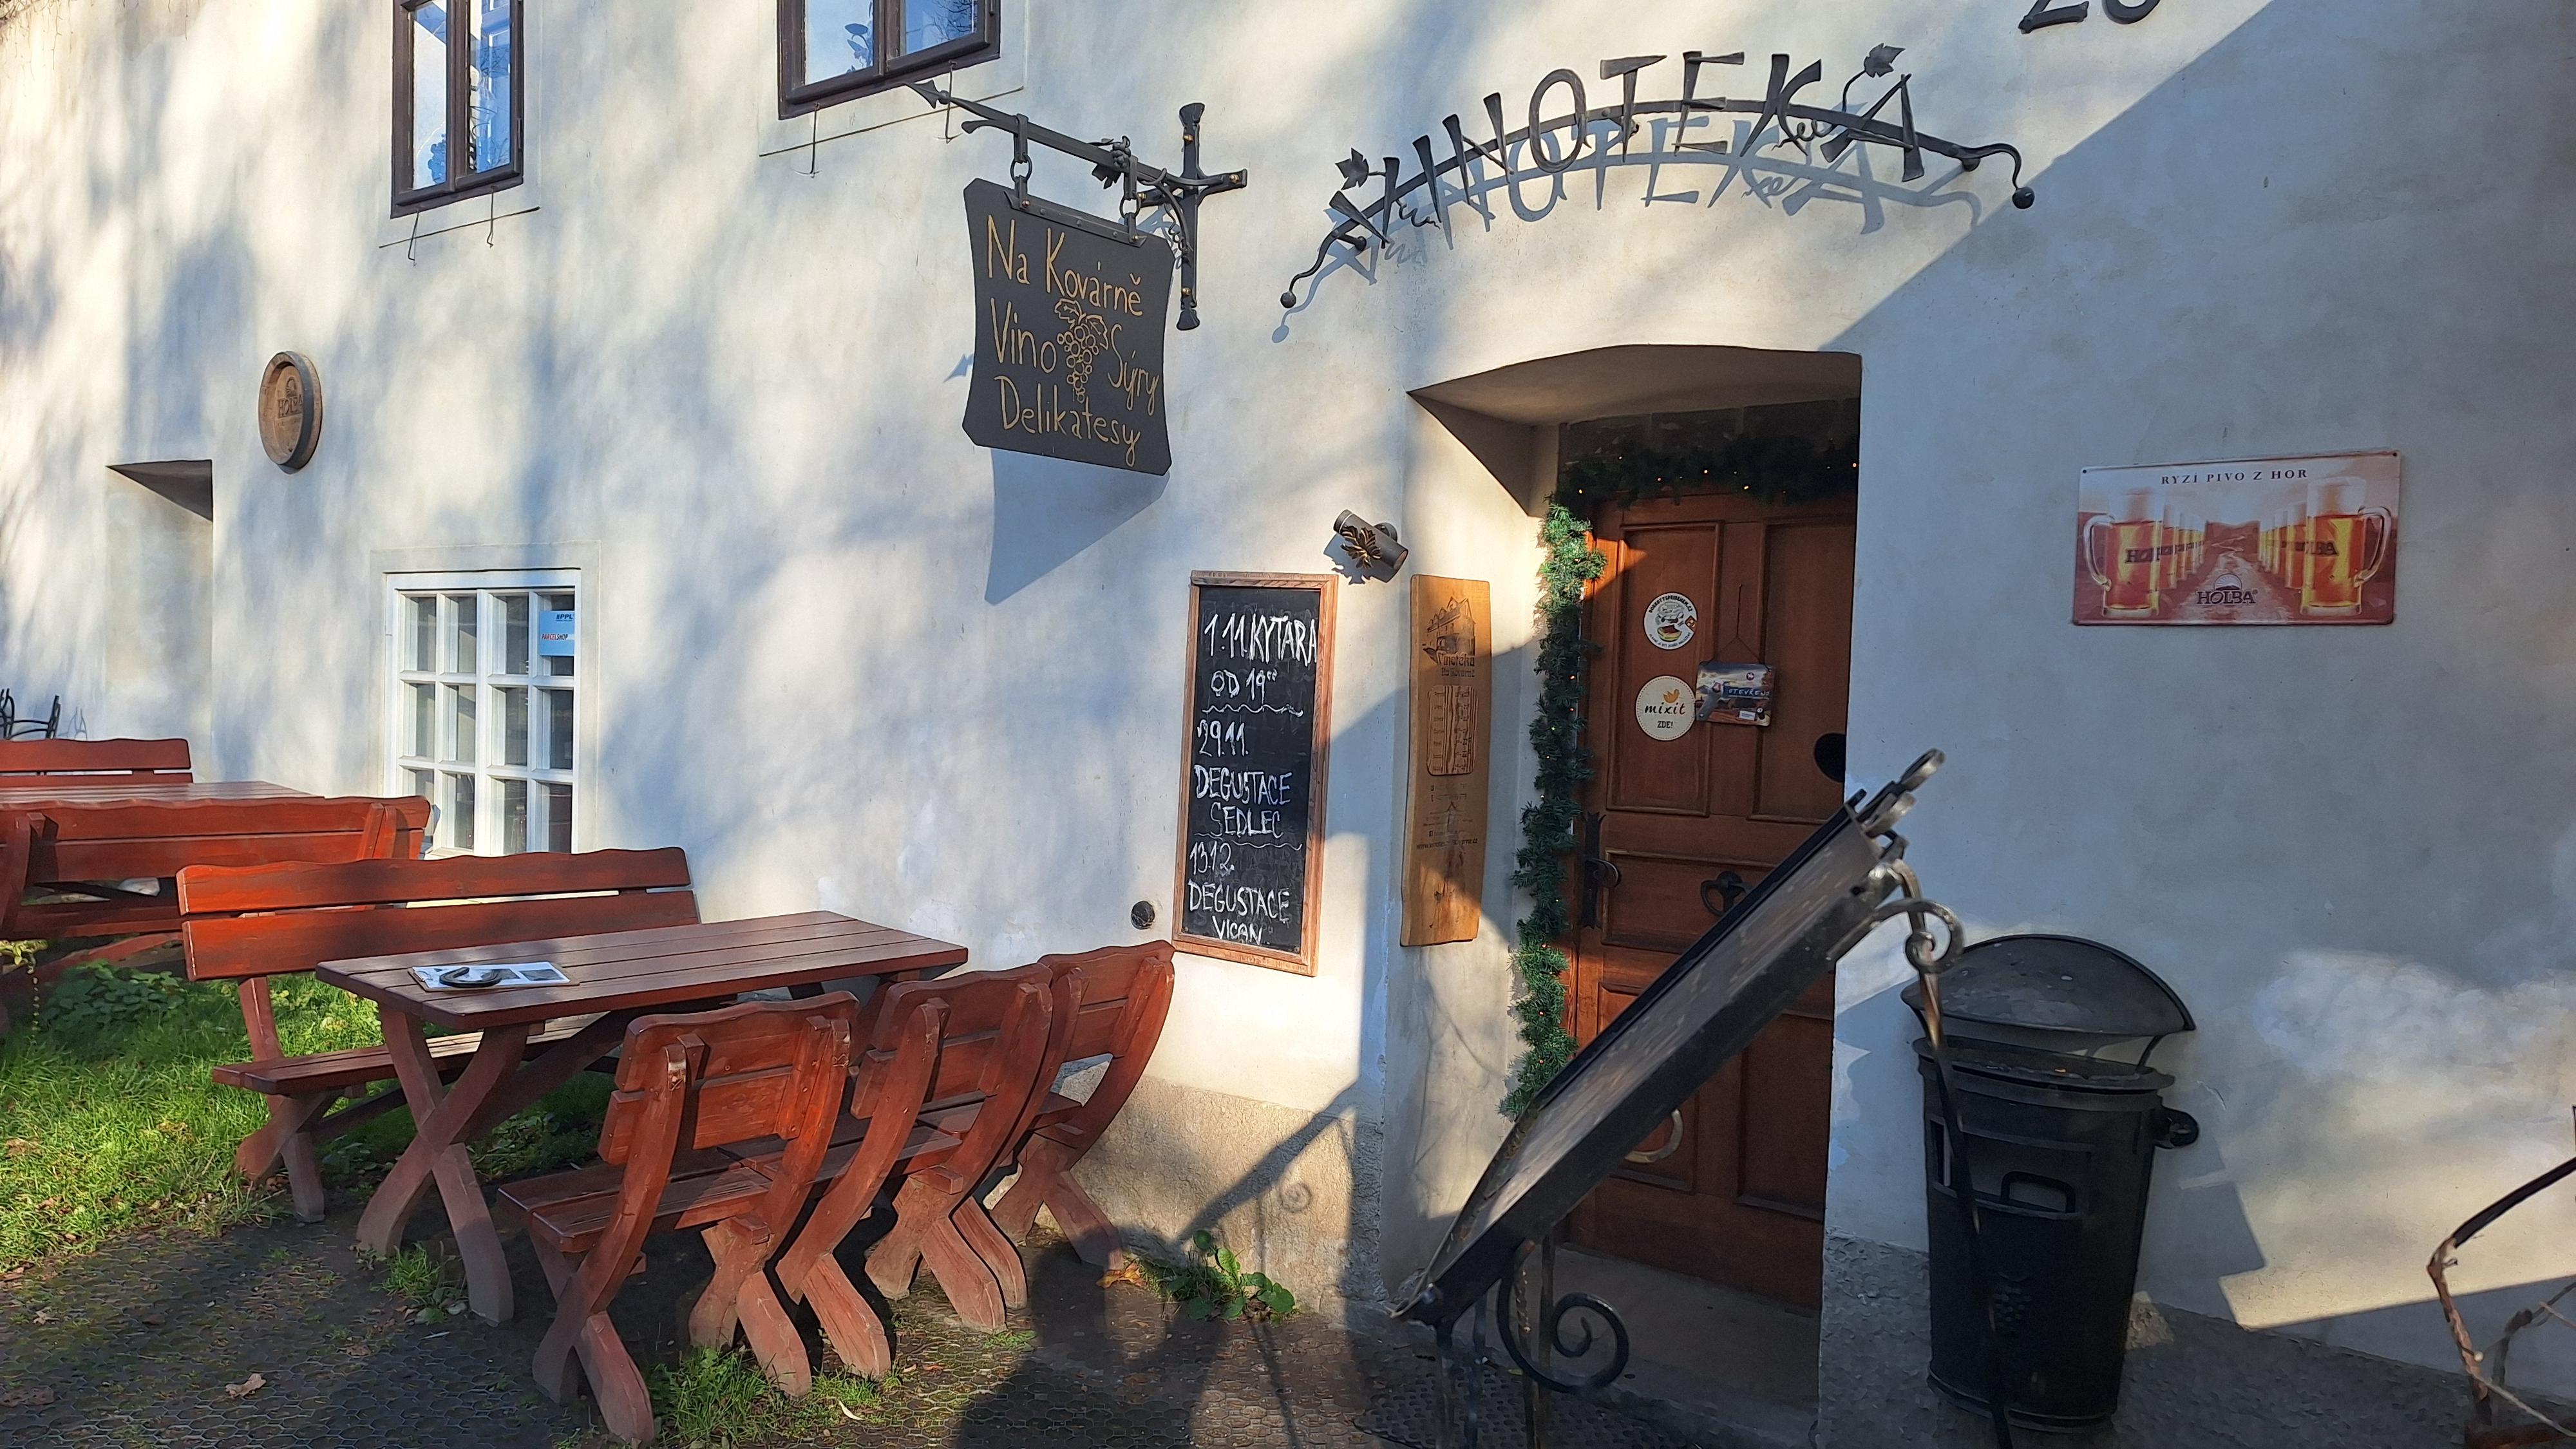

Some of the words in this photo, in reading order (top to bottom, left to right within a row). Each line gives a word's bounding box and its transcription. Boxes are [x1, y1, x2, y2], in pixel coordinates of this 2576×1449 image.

[988, 214, 1030, 284] Na
[1046, 227, 1143, 316] Kovárně
[1108, 323, 1159, 416] Sýry
[994, 375, 1142, 467] Delikatesy
[2161, 473, 2197, 484] RYZÍ
[2206, 472, 2245, 482] PIVO
[2253, 471, 2262, 480] Z
[2271, 469, 2307, 480] HOR
[2197, 591, 2256, 604] HOLBA
[1249, 613, 1317, 667] KYTARA
[1211, 669, 1240, 698] OD
[1644, 702, 1685, 715] mixit
[1193, 764, 1293, 805] DEGUSTACE
[1209, 802, 1283, 838] SEDLEC
[1187, 879, 1291, 924] DEGUSTACE
